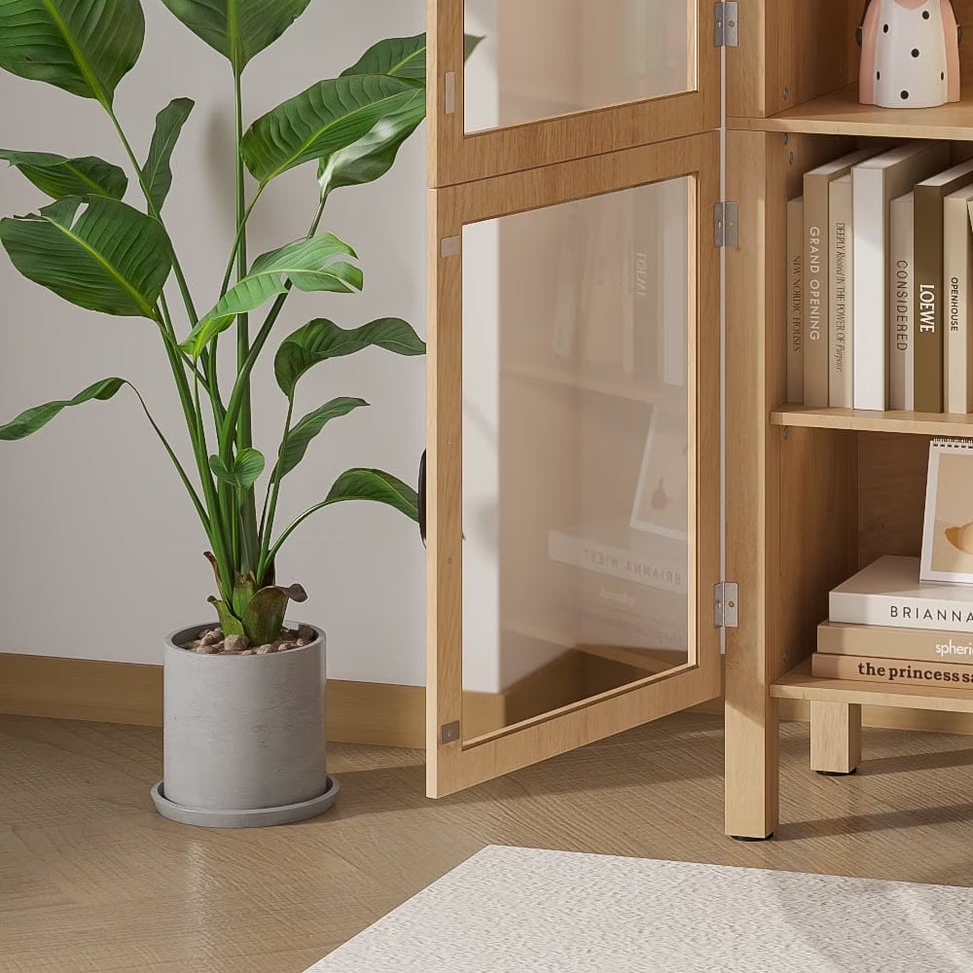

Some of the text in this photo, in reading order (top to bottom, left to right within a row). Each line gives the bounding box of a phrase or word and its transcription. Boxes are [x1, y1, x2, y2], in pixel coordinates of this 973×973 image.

[809, 226, 820, 341] GRAND OPENING
[836, 288, 845, 302] THE
[896, 260, 908, 351] CONSIDERED
[920, 284, 935, 333] LOEWE
[950, 276, 959, 332] OPENHOUSE
[858, 661, 886, 677] the
[888, 665, 960, 682] princess
